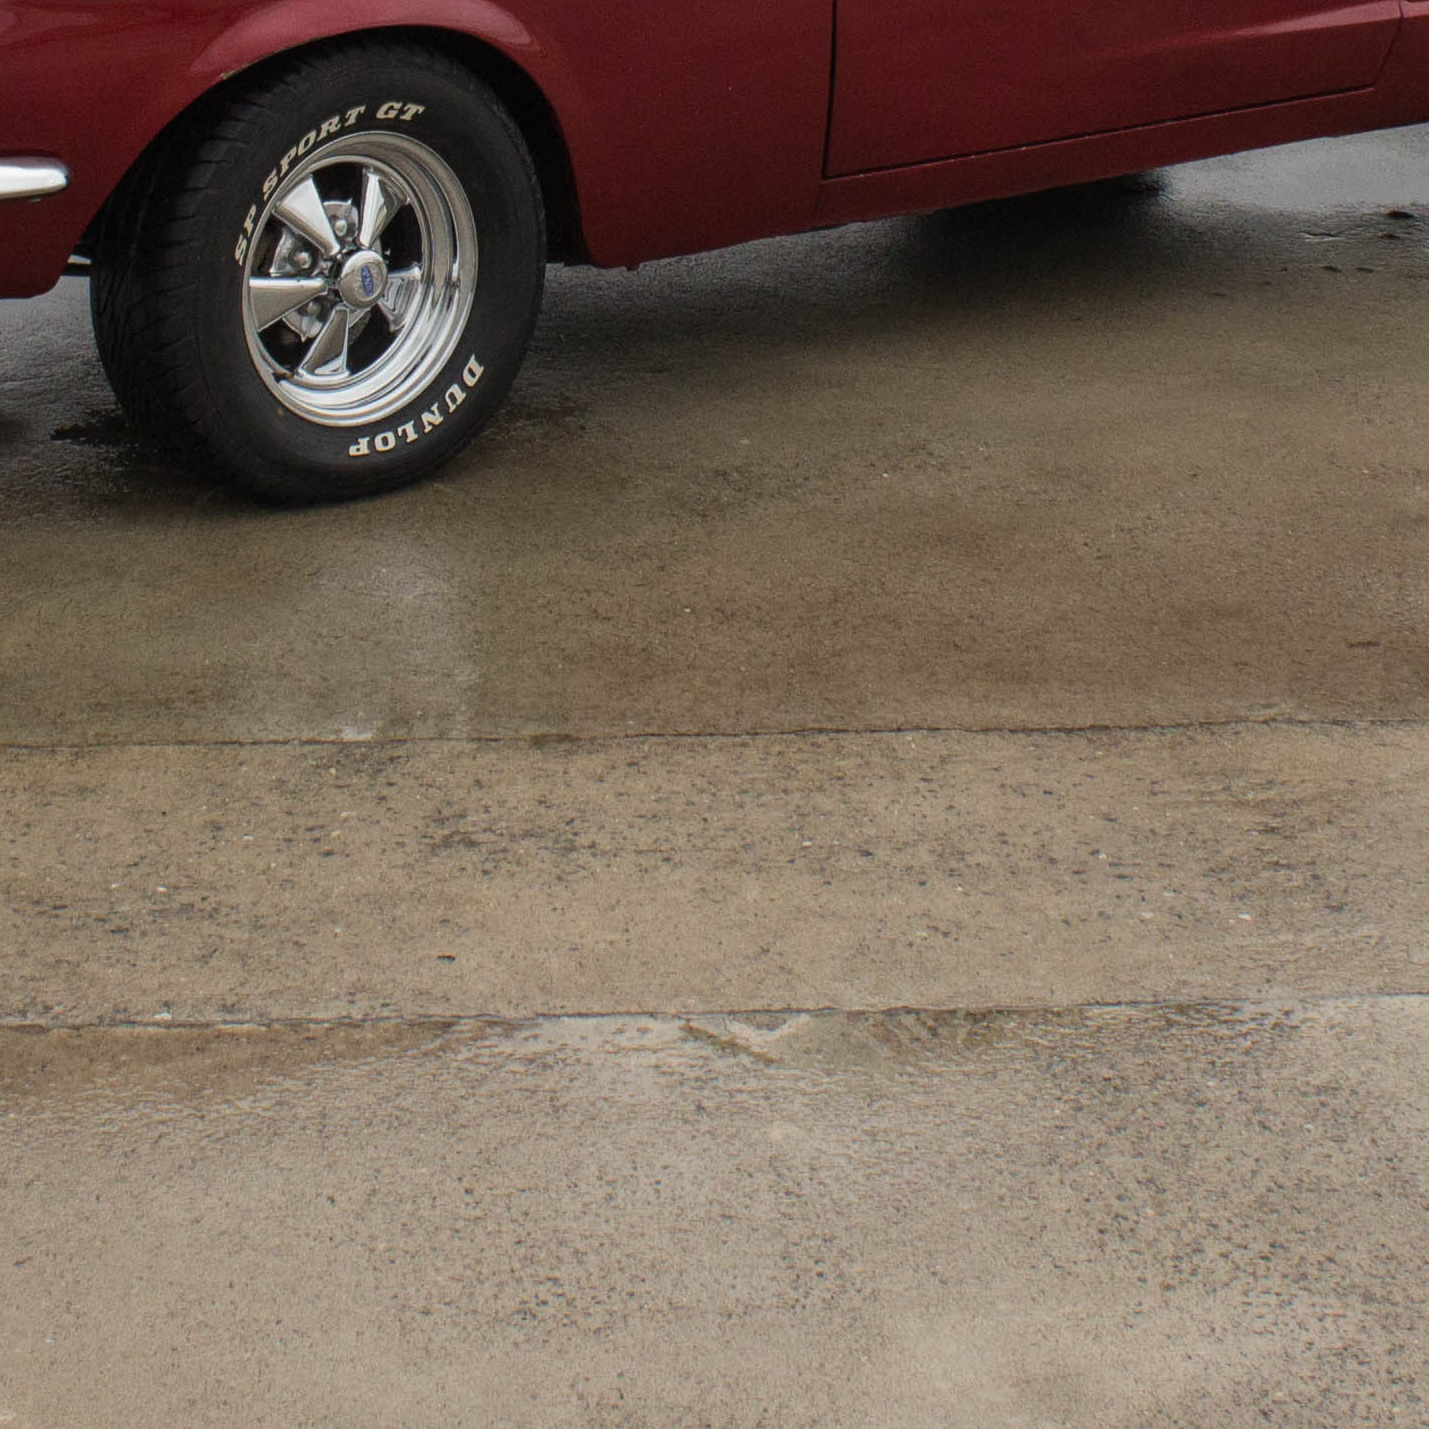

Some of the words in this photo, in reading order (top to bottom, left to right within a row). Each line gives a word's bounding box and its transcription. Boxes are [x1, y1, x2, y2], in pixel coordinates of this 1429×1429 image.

[234, 204, 256, 267] SP
[262, 105, 367, 201] SPORT
[375, 101, 426, 122] GT
[348, 352, 486, 458] DUNLOP
